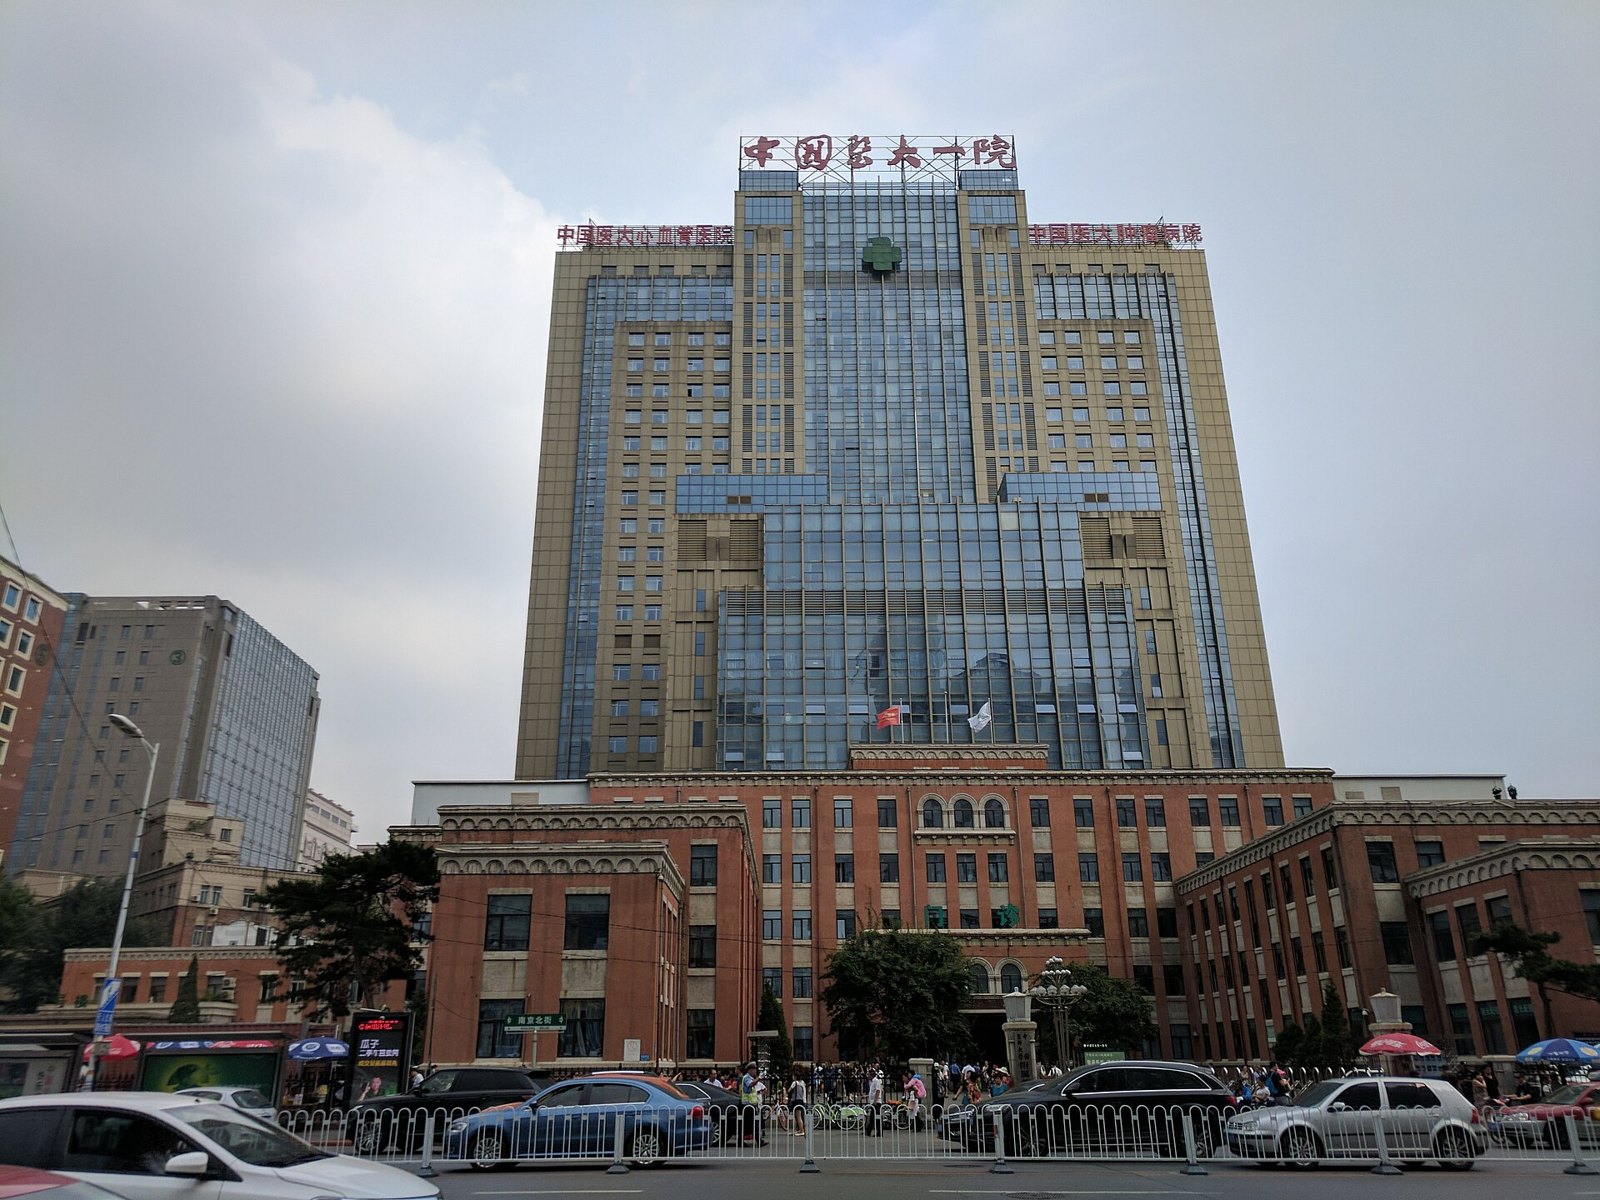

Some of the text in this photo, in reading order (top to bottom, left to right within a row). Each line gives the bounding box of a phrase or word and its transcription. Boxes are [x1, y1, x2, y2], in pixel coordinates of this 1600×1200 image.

[557, 224, 733, 246] 中国医大心血管医院
[518, 1016, 552, 1025] 南京北街
[359, 1039, 380, 1049] 瓜子
